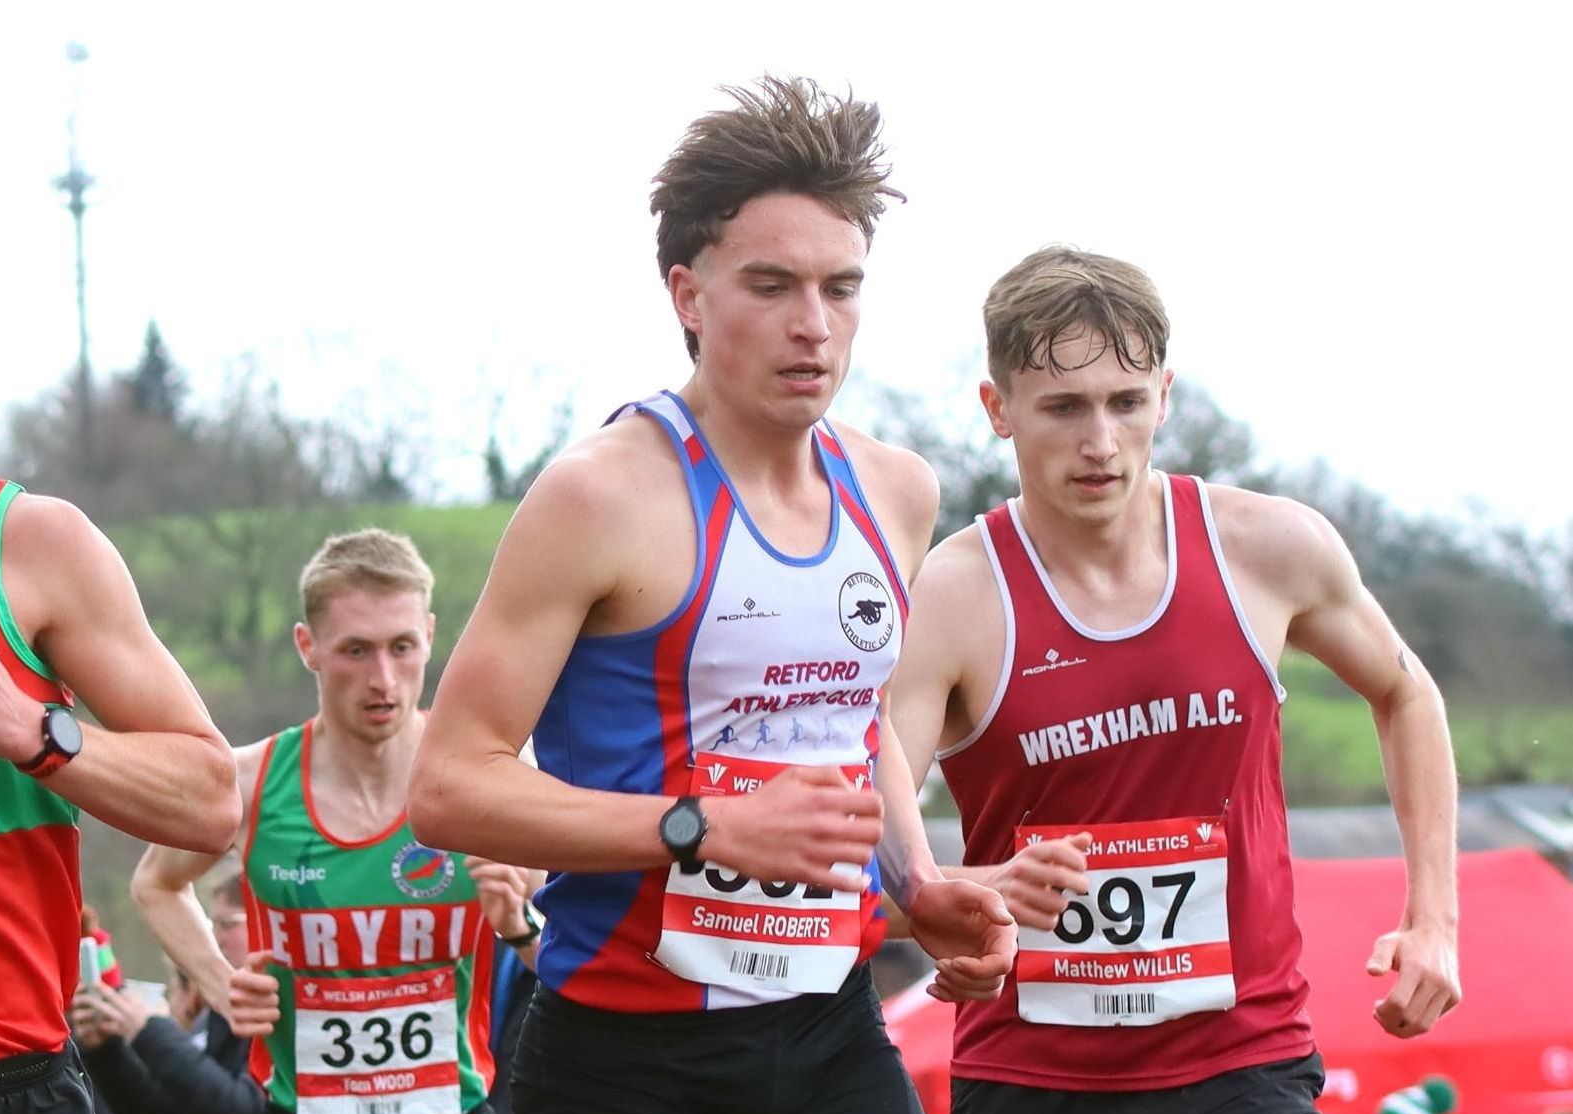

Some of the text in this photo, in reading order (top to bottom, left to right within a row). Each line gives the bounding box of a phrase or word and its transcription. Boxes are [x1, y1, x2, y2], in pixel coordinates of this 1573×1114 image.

[847, 574, 880, 589] RETFORD
[717, 611, 781, 622] RONHILL
[842, 622, 893, 649] ATHLETIC CLUB
[764, 660, 860, 686] RETFORD
[1022, 656, 1087, 676] RONHILL
[723, 688, 873, 714] ATHLETIC CLUB
[1018, 688, 1243, 767] WREXHAM A.C.
[1107, 834, 1189, 855] ATHLETICS
[269, 864, 326, 885] Teejac
[692, 905, 830, 939] Samuel ROBERTS
[268, 905, 467, 968] ERYRI
[1054, 952, 1193, 979] Matthew WILLIS
[324, 982, 428, 1002] WELSH ATHLETICS
[320, 1011, 433, 1068] 336
[343, 1075, 416, 1092] Tom WOOD
